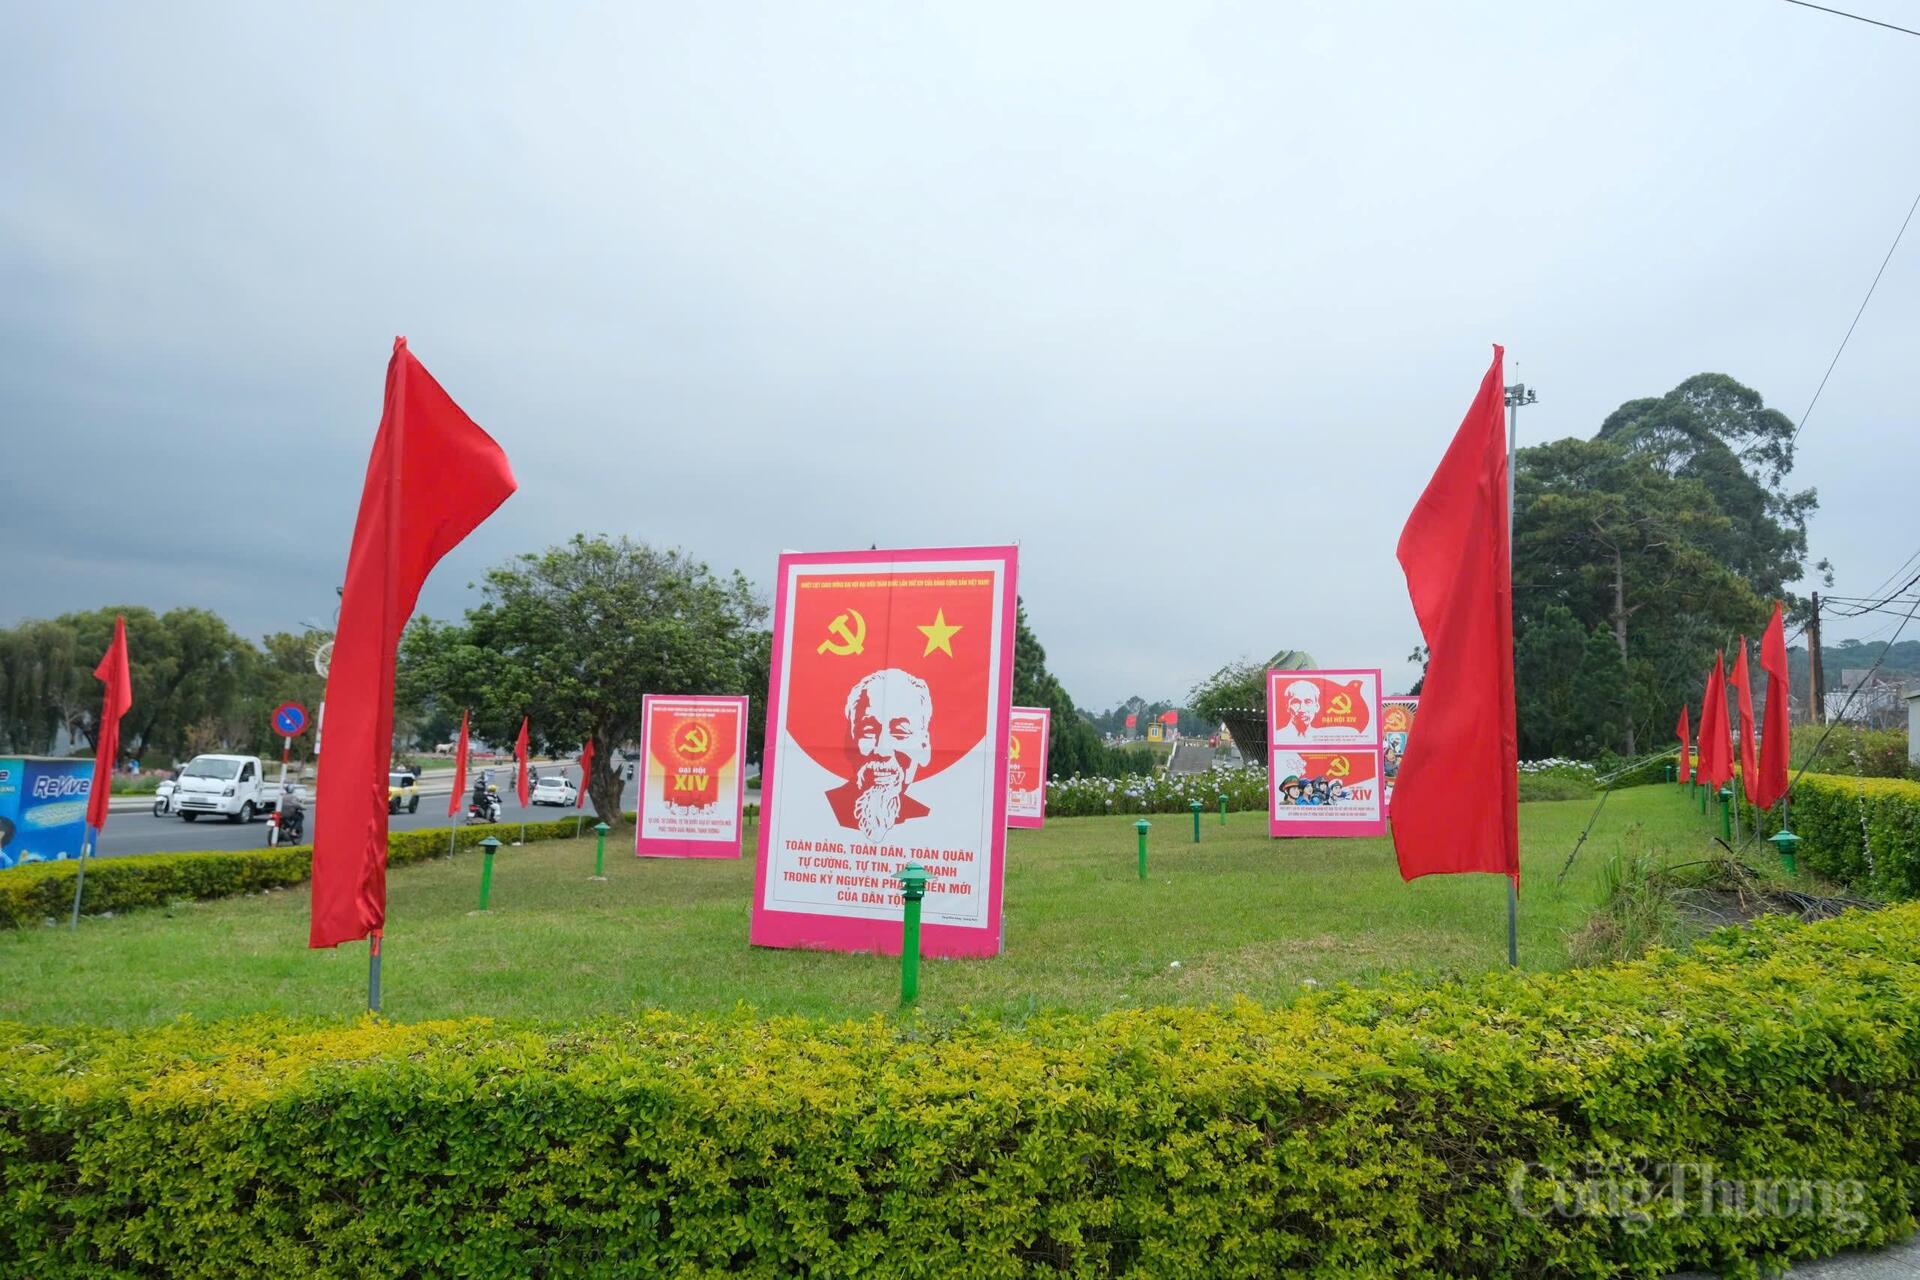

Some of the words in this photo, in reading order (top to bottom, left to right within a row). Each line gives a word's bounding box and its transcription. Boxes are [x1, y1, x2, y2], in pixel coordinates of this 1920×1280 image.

[673, 774, 709, 791] XIV
[1351, 789, 1372, 800] XIV
[785, 839, 812, 851] TOÀN
[815, 838, 846, 854] ĐẢNG,
[850, 842, 877, 855] TOÀN
[880, 845, 906, 858] DÂN,
[910, 847, 939, 859] TOÀN
[942, 849, 974, 862] QUÂN
[799, 856, 812, 869] TỰ
[814, 855, 852, 870] CƯỜNG,
[856, 860, 869, 873] TỰ
[872, 861, 891, 873] TIN,
[784, 871, 817, 883] TRONG
[820, 869, 833, 885] KỶ
[836, 875, 878, 888] NGUYÊN
[949, 881, 971, 895] MỚI
[837, 887, 858, 902] CỦA
[861, 891, 884, 904] DÂN
